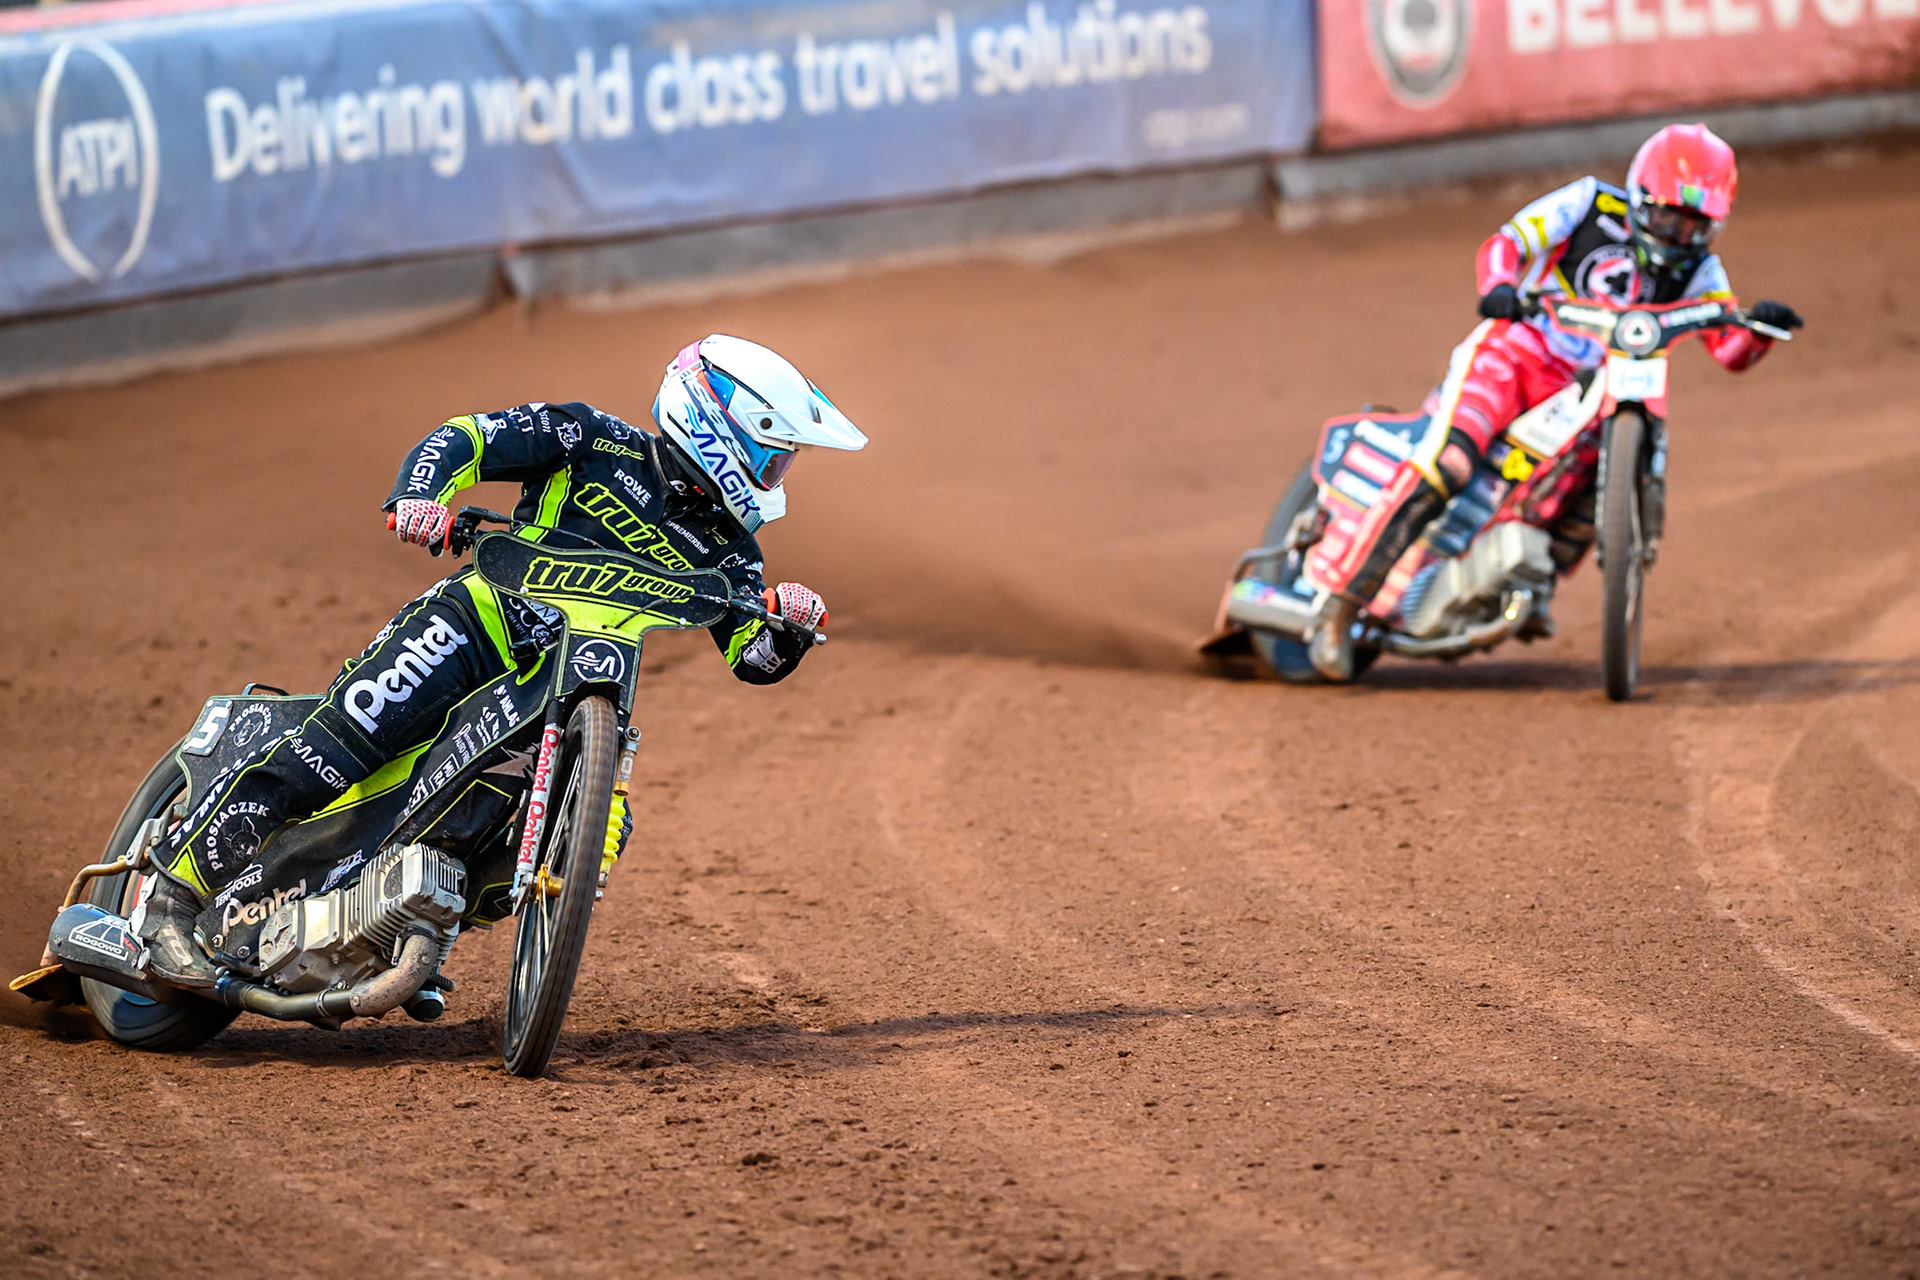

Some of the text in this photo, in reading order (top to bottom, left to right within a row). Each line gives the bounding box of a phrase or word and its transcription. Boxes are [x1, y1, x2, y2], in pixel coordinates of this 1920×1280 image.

[205, 1, 1212, 182] Delivering world class travel solutions
[57, 117, 139, 199] ATPI
[406, 427, 456, 494] MAGIK
[613, 468, 652, 504] ROWE
[522, 556, 696, 604] tru7group
[344, 614, 469, 735] Pentel
[183, 706, 231, 751] 5
[532, 728, 561, 794] Pentel
[206, 801, 271, 872] PROSIACZEK
[517, 800, 545, 865] Pentel
[222, 878, 308, 939] Pentel
[74, 933, 123, 955] ROGOWO
